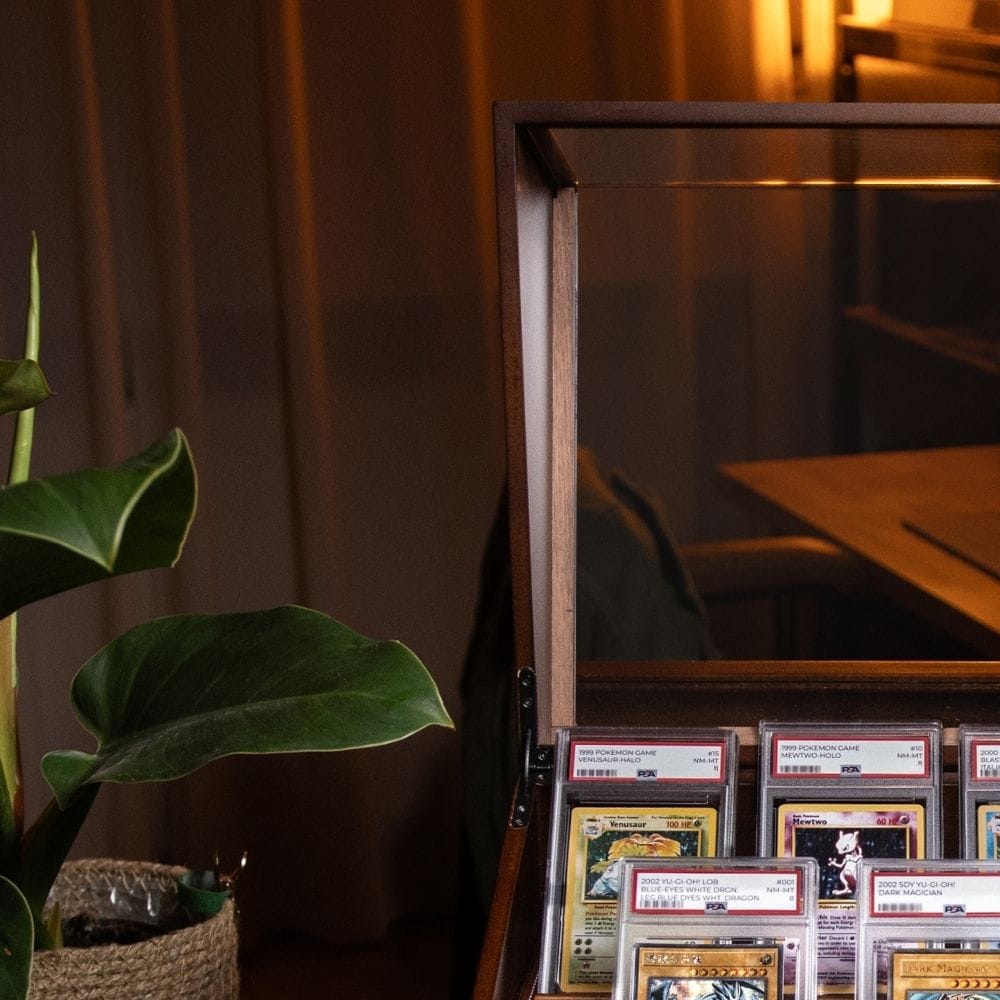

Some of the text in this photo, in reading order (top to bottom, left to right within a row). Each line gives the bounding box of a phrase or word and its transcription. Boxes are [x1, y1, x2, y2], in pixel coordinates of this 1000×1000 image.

[637, 770, 657, 778] PSA
[841, 766, 860, 774] PSA
[609, 820, 647, 828] Venusaur
[666, 820, 680, 828] 100
[706, 902, 726, 911] PSA
[944, 905, 965, 914] PSA
